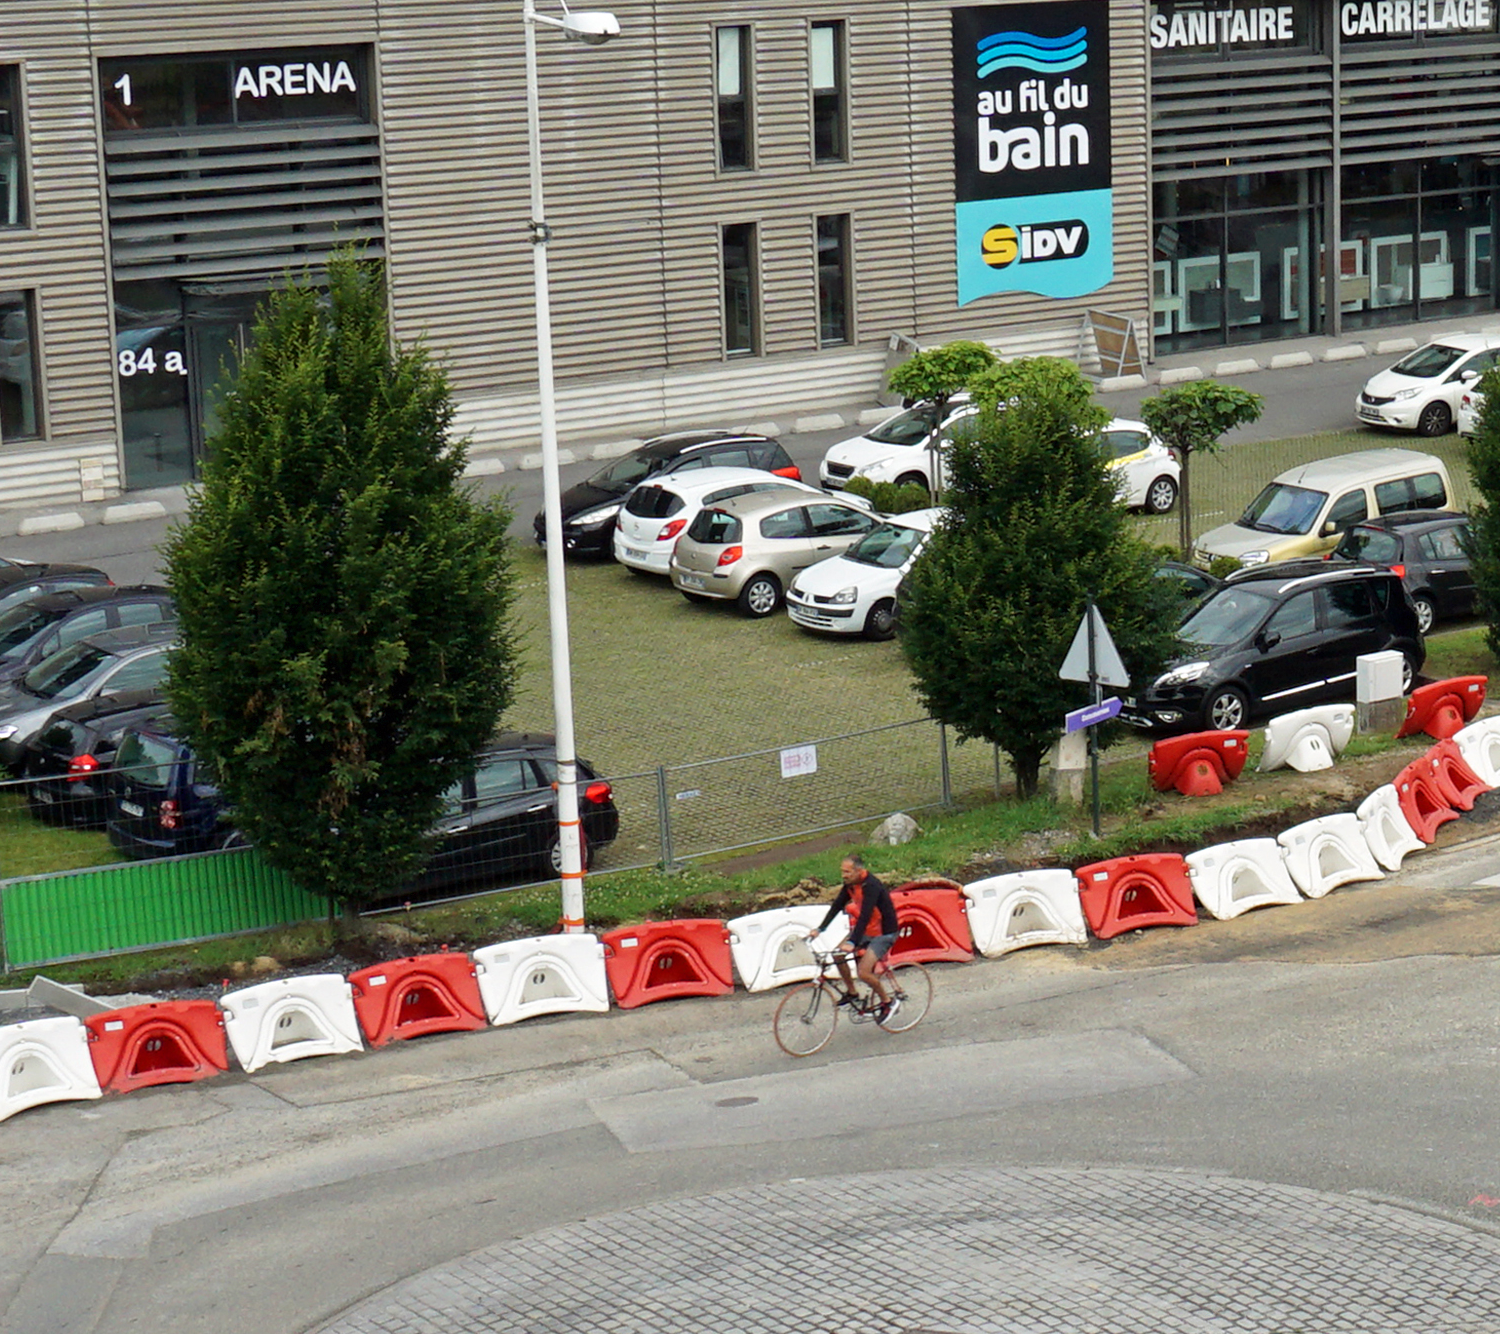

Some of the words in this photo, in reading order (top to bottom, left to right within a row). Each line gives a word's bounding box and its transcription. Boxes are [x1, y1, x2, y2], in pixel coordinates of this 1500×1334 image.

[1150, 5, 1294, 49] SANITAIRE
[114, 73, 132, 106] 1
[234, 61, 356, 99] ARENA
[977, 88, 1012, 116] au
[1019, 78, 1049, 112] fil
[1054, 77, 1089, 110] du
[977, 111, 1090, 173] bain
[118, 347, 157, 377] 84
